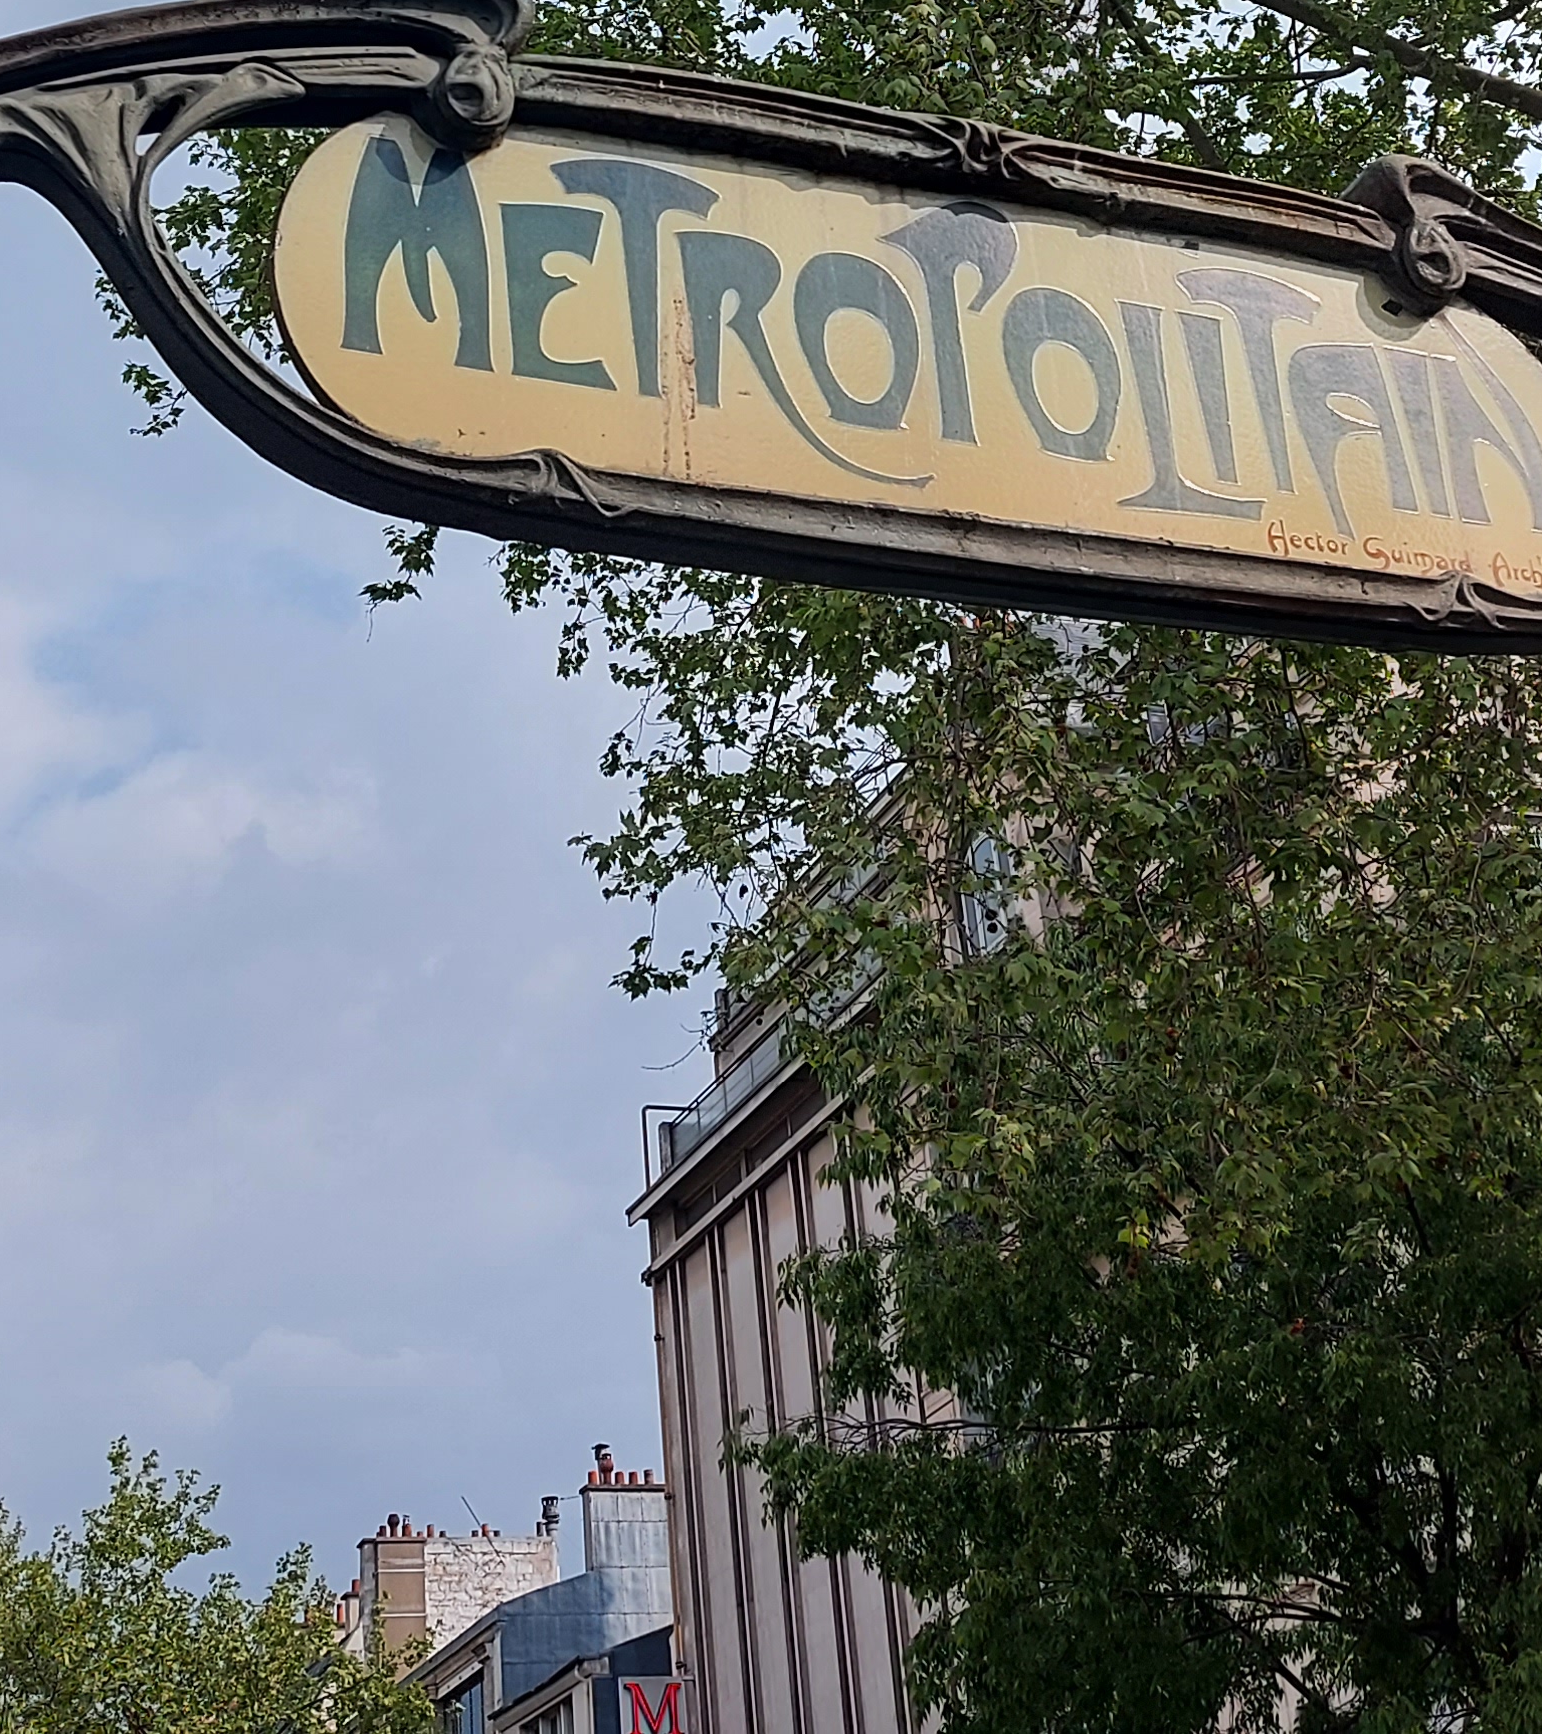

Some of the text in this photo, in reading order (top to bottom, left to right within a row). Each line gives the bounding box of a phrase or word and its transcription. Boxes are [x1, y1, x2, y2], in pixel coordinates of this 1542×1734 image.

[1267, 519, 1348, 558] Hector
[1363, 536, 1474, 576] Guimard
[623, 1682, 684, 1734] M
